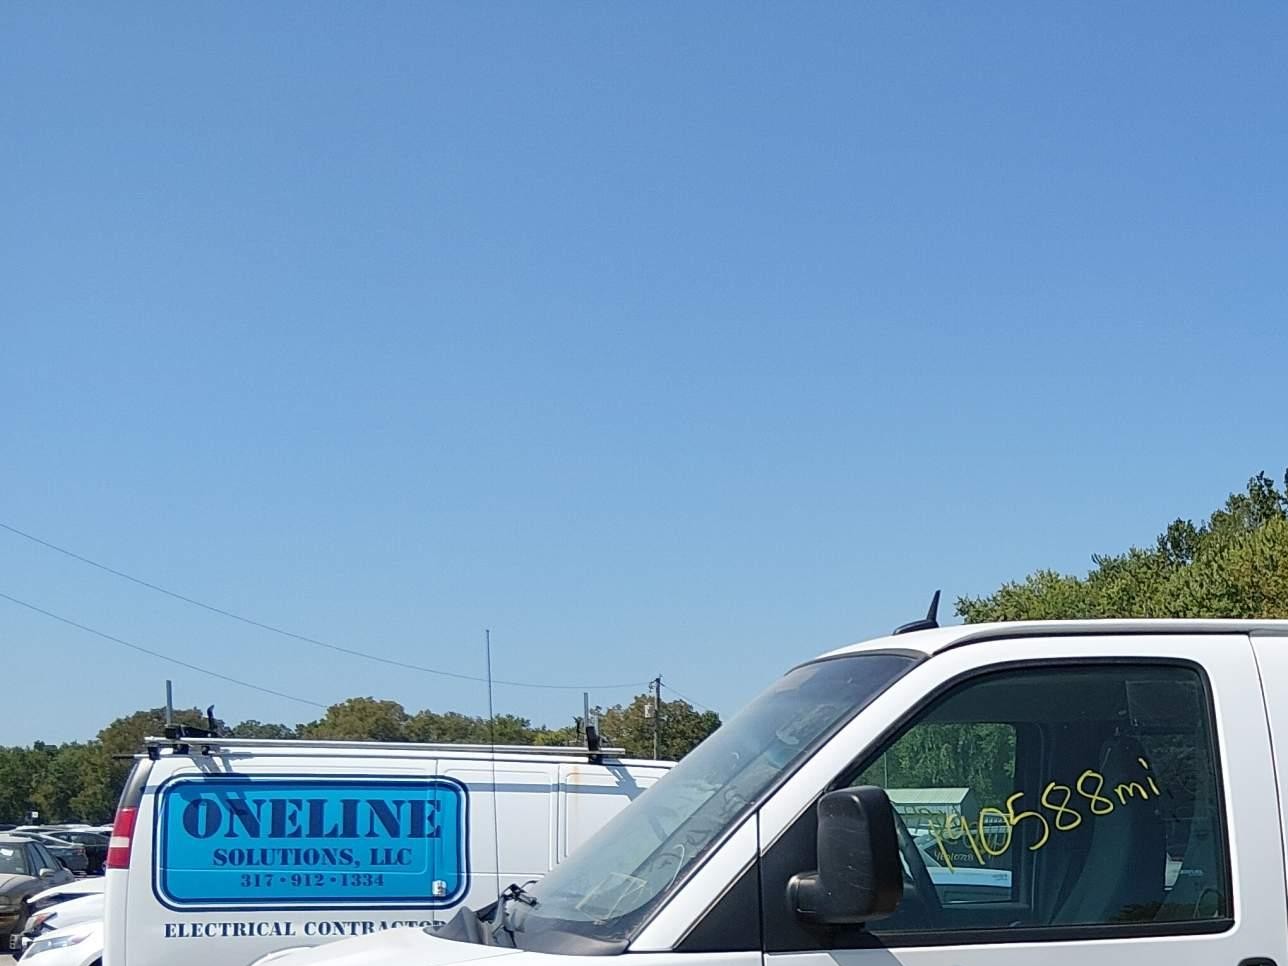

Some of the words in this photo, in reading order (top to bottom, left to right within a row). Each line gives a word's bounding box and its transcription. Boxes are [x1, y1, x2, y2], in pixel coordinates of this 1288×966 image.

[182, 799, 441, 839] ONELINE
[212, 848, 361, 868] SOLUTIONS,
[370, 848, 412, 866] LLC
[164, 921, 296, 938] ELECTRICAL
